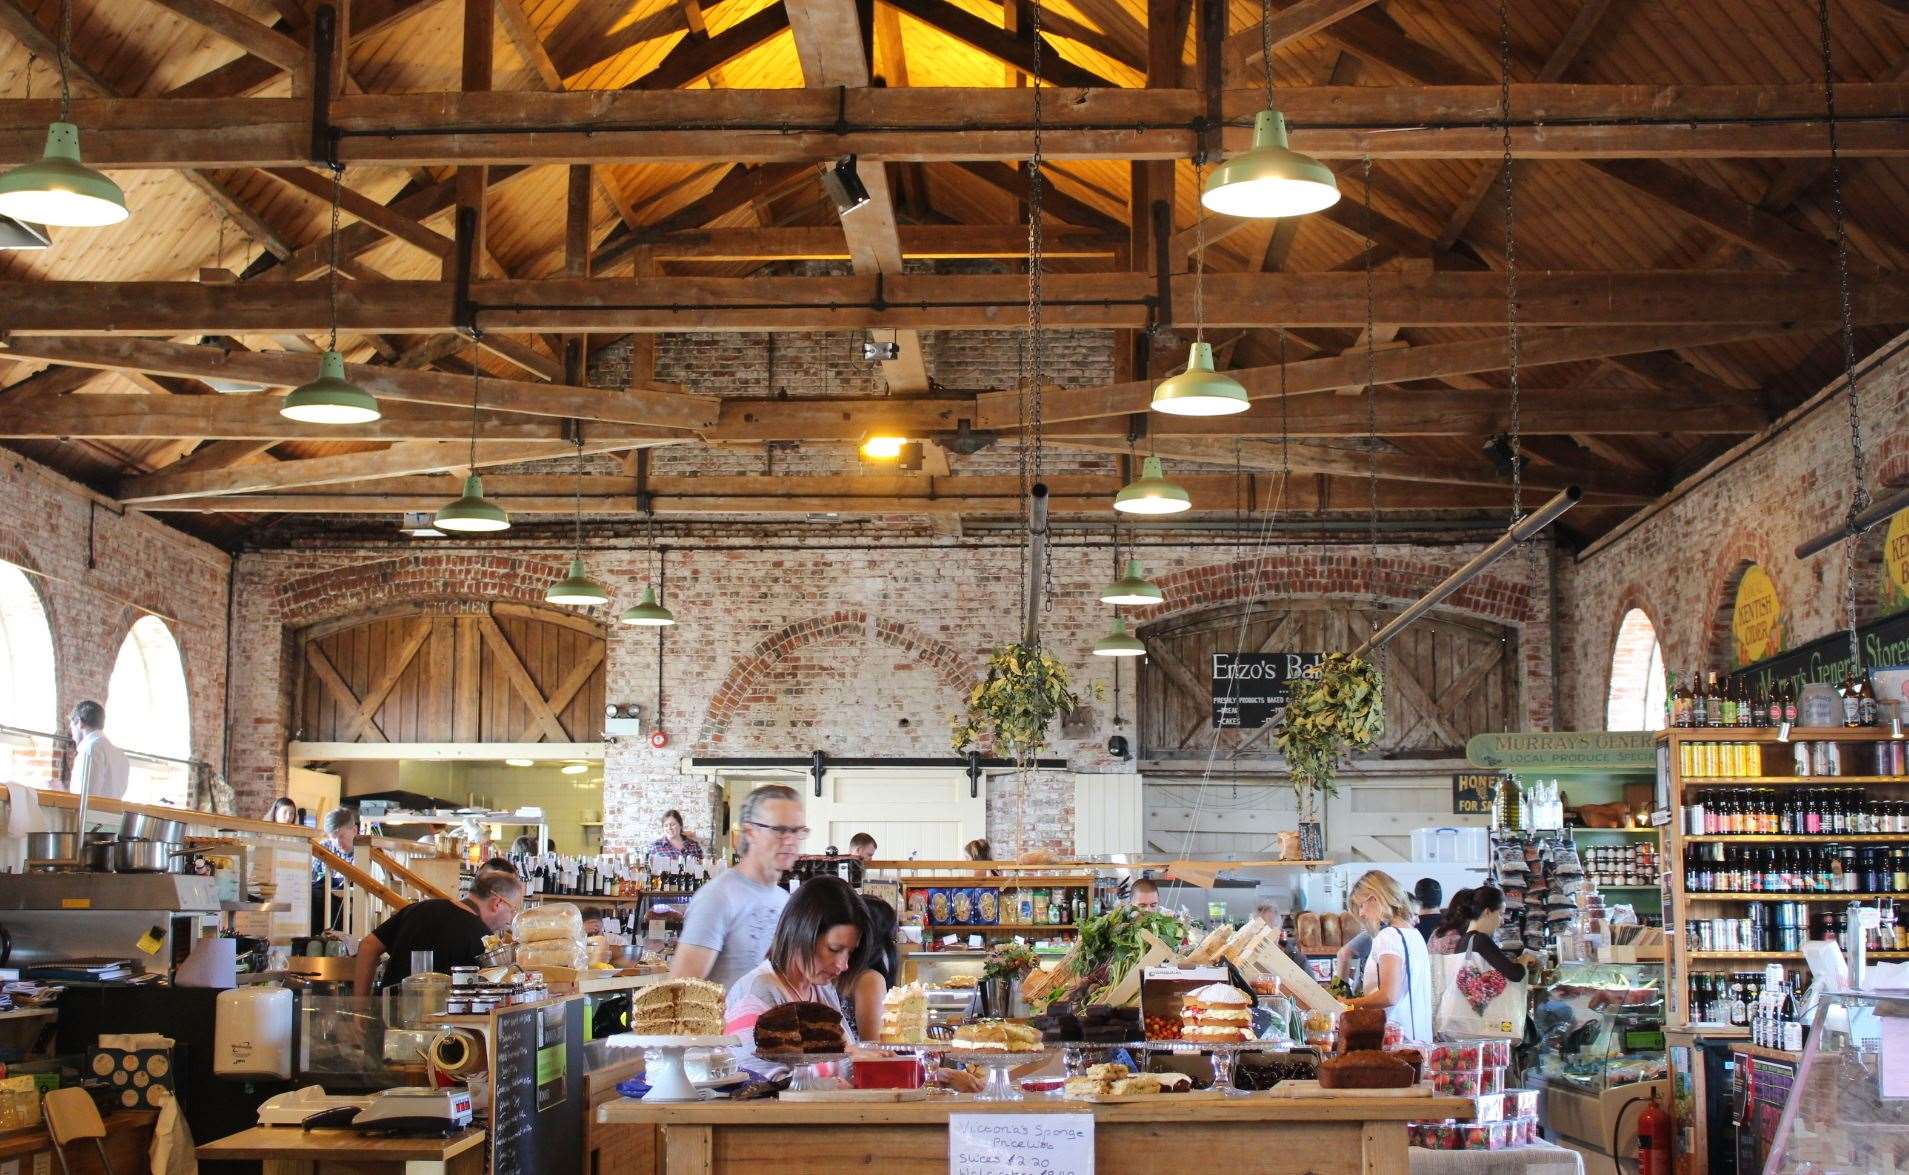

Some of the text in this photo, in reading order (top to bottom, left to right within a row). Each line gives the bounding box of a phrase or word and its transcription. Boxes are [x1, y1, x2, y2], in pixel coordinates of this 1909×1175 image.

[423, 600, 490, 615] KITCHEN
[1738, 594, 1772, 625] KENTISH
[1213, 653, 1276, 680] Enzo's
[1267, 696, 1284, 704] BAKED
[1510, 753, 1545, 762] LOCAL
[1552, 753, 1609, 762] PRODUCE
[1459, 800, 1478, 812] FOR
[1035, 1124, 1084, 1141] Sponge
[959, 1153, 1000, 1164] Slices
